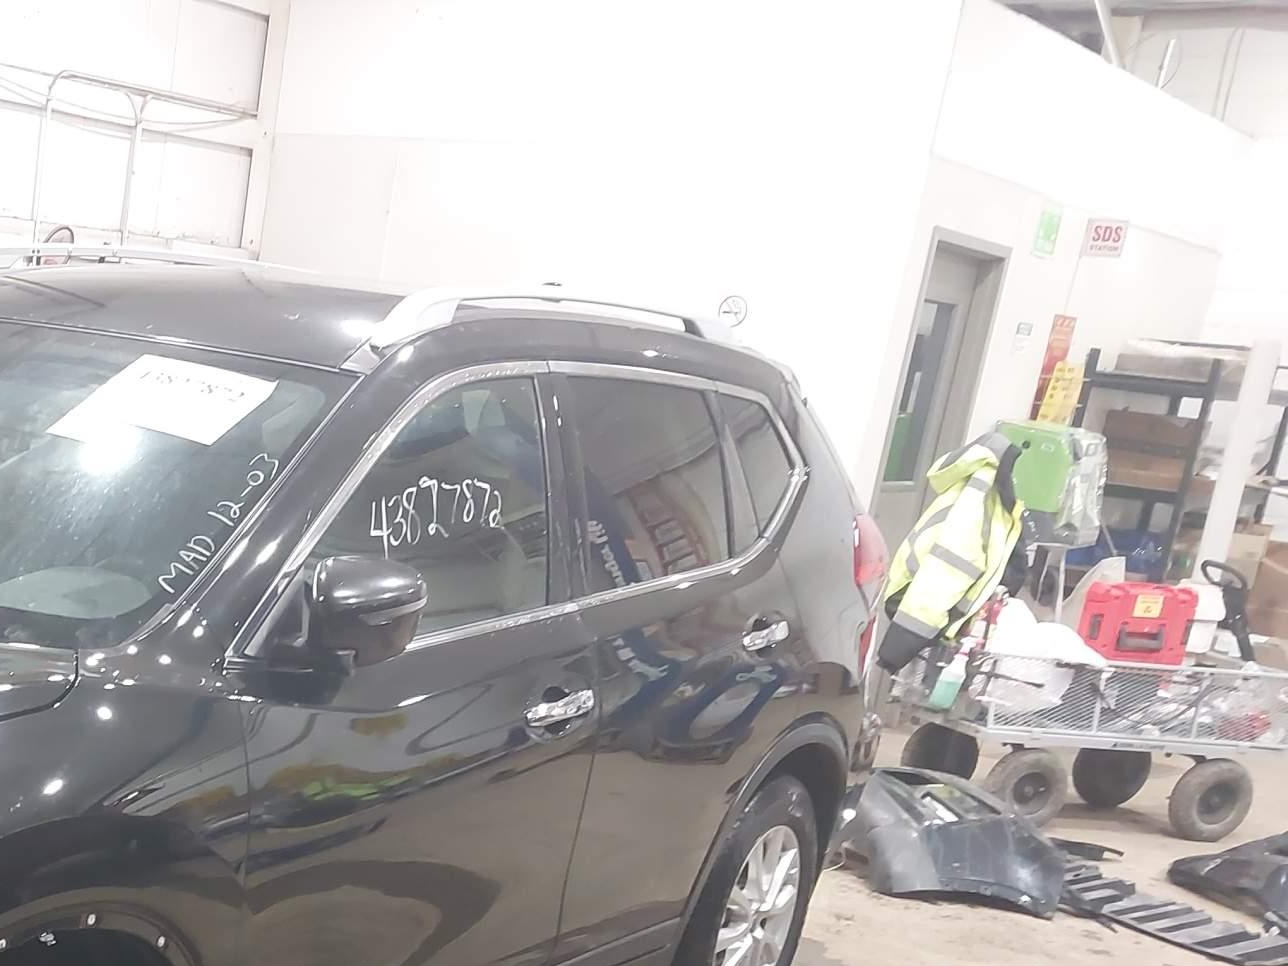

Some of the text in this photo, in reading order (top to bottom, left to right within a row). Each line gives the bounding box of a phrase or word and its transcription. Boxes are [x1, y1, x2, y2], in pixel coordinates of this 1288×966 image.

[1092, 225, 1124, 243] SDS
[158, 453, 279, 593] MAD 12-03
[369, 475, 505, 560] 43827872
